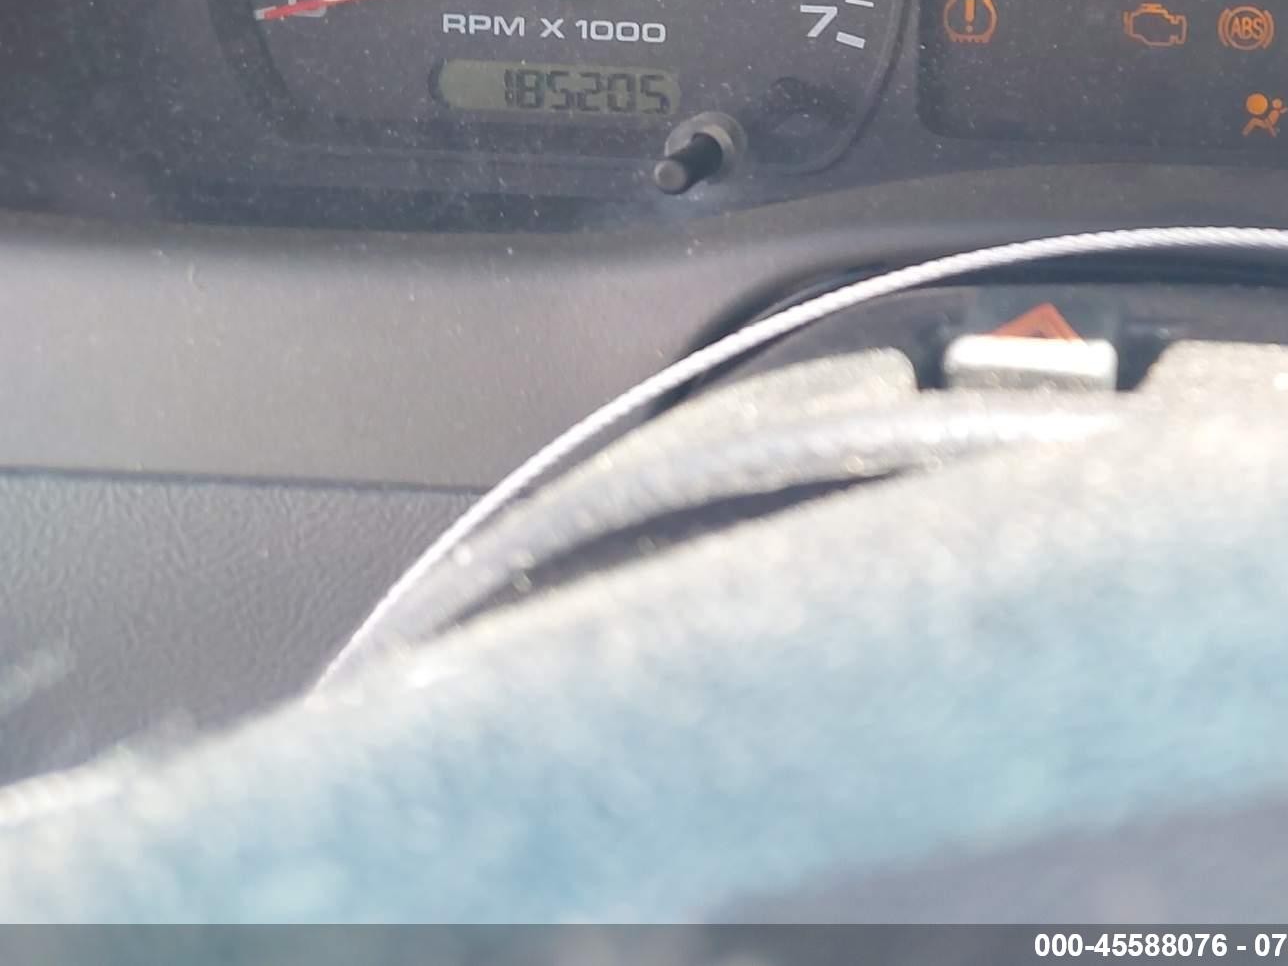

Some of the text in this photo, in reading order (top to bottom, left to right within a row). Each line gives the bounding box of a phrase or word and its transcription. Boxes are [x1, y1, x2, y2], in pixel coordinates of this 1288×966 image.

[442, 13, 666, 43] RPM X 1000
[799, 5, 838, 39] 7
[1231, 15, 1264, 40] ABS
[503, 68, 672, 114] 185205
